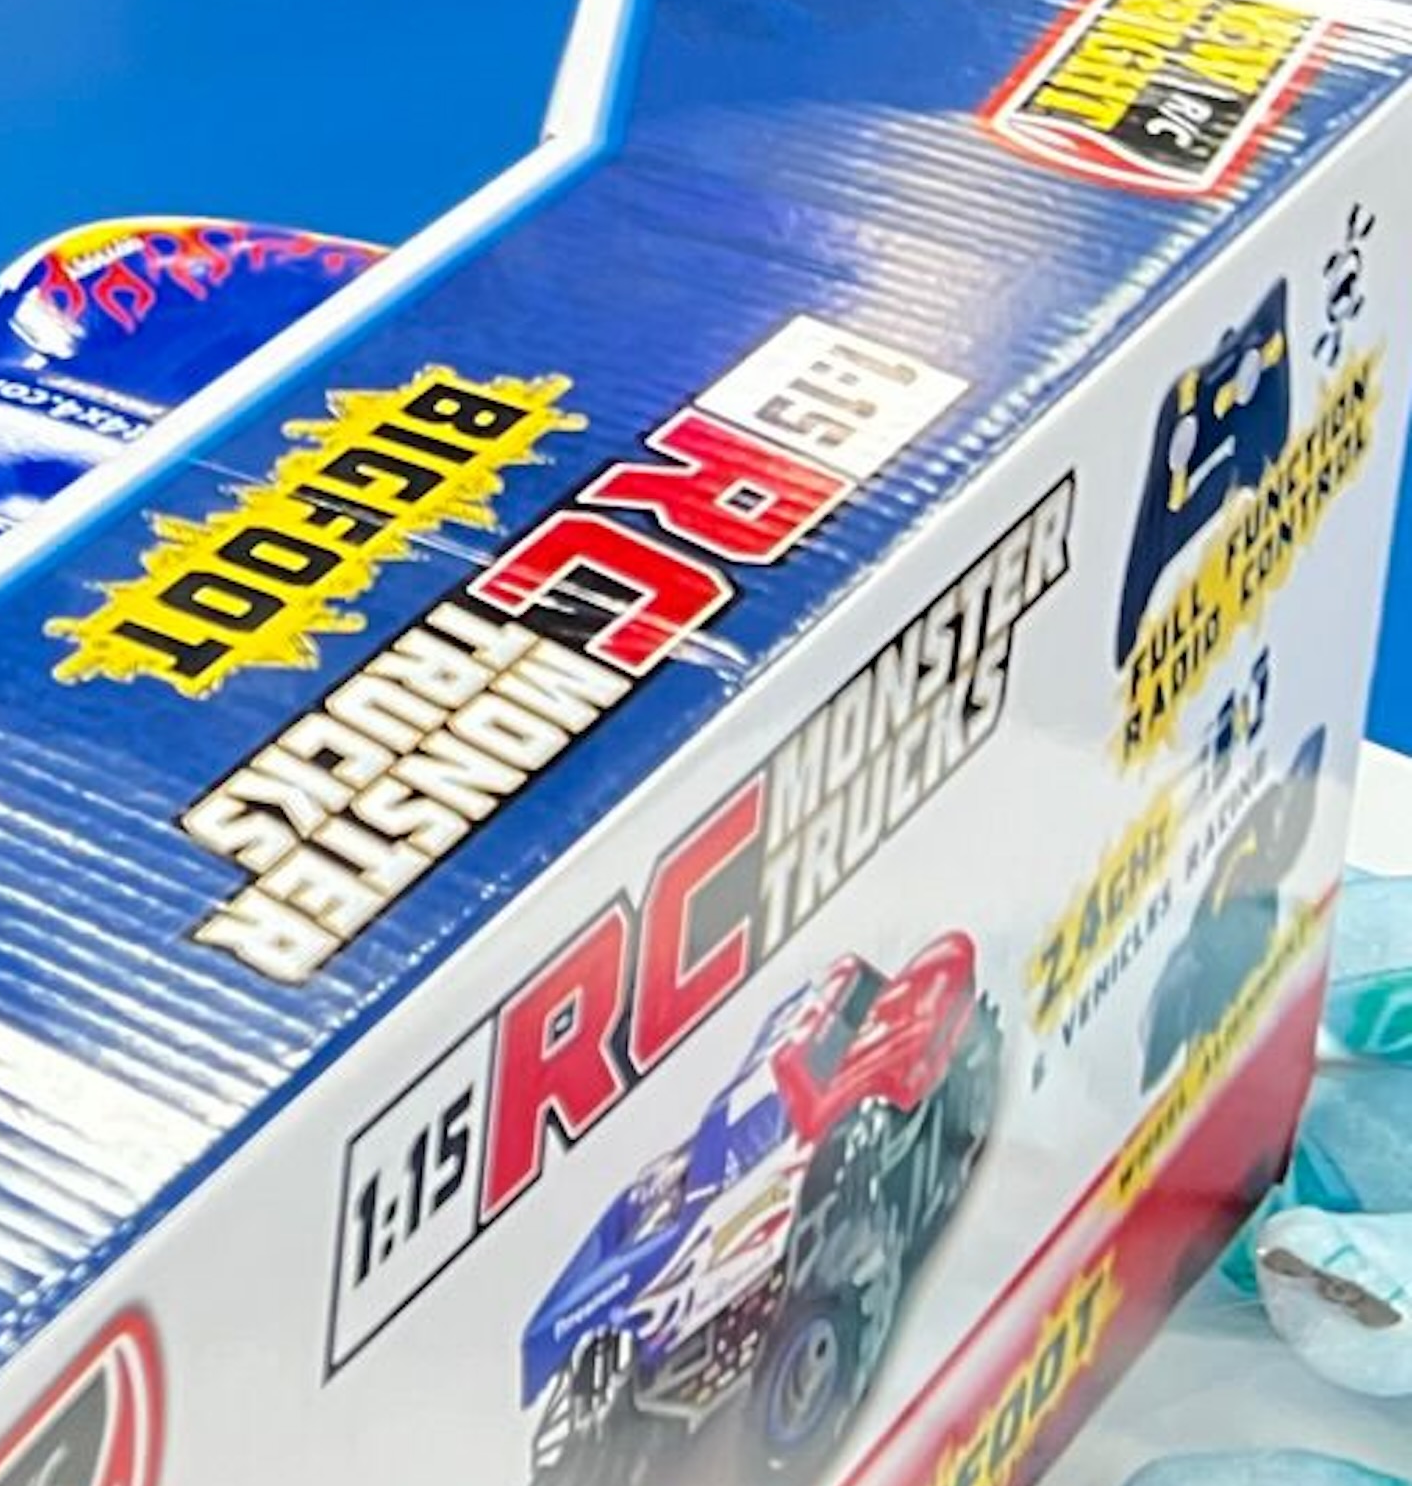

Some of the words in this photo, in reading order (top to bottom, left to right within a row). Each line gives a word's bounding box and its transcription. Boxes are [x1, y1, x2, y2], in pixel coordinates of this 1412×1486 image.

[1144, 93, 1214, 149] R/C
[111, 383, 534, 680] BIGFOOT
[467, 406, 858, 678] RC
[754, 342, 919, 449] 1:15
[1130, 582, 1206, 698] FULL
[1226, 359, 1372, 578] FUNCTION
[180, 600, 540, 871] TRUCKS
[768, 476, 1078, 850] MONSTER
[1123, 611, 1220, 764] RADIO
[1240, 416, 1368, 606] CONTROL
[188, 637, 635, 985] MONSTER
[762, 619, 1015, 960] TRUCKS
[351, 1091, 473, 1288] 1:15
[480, 776, 766, 1225] RC
